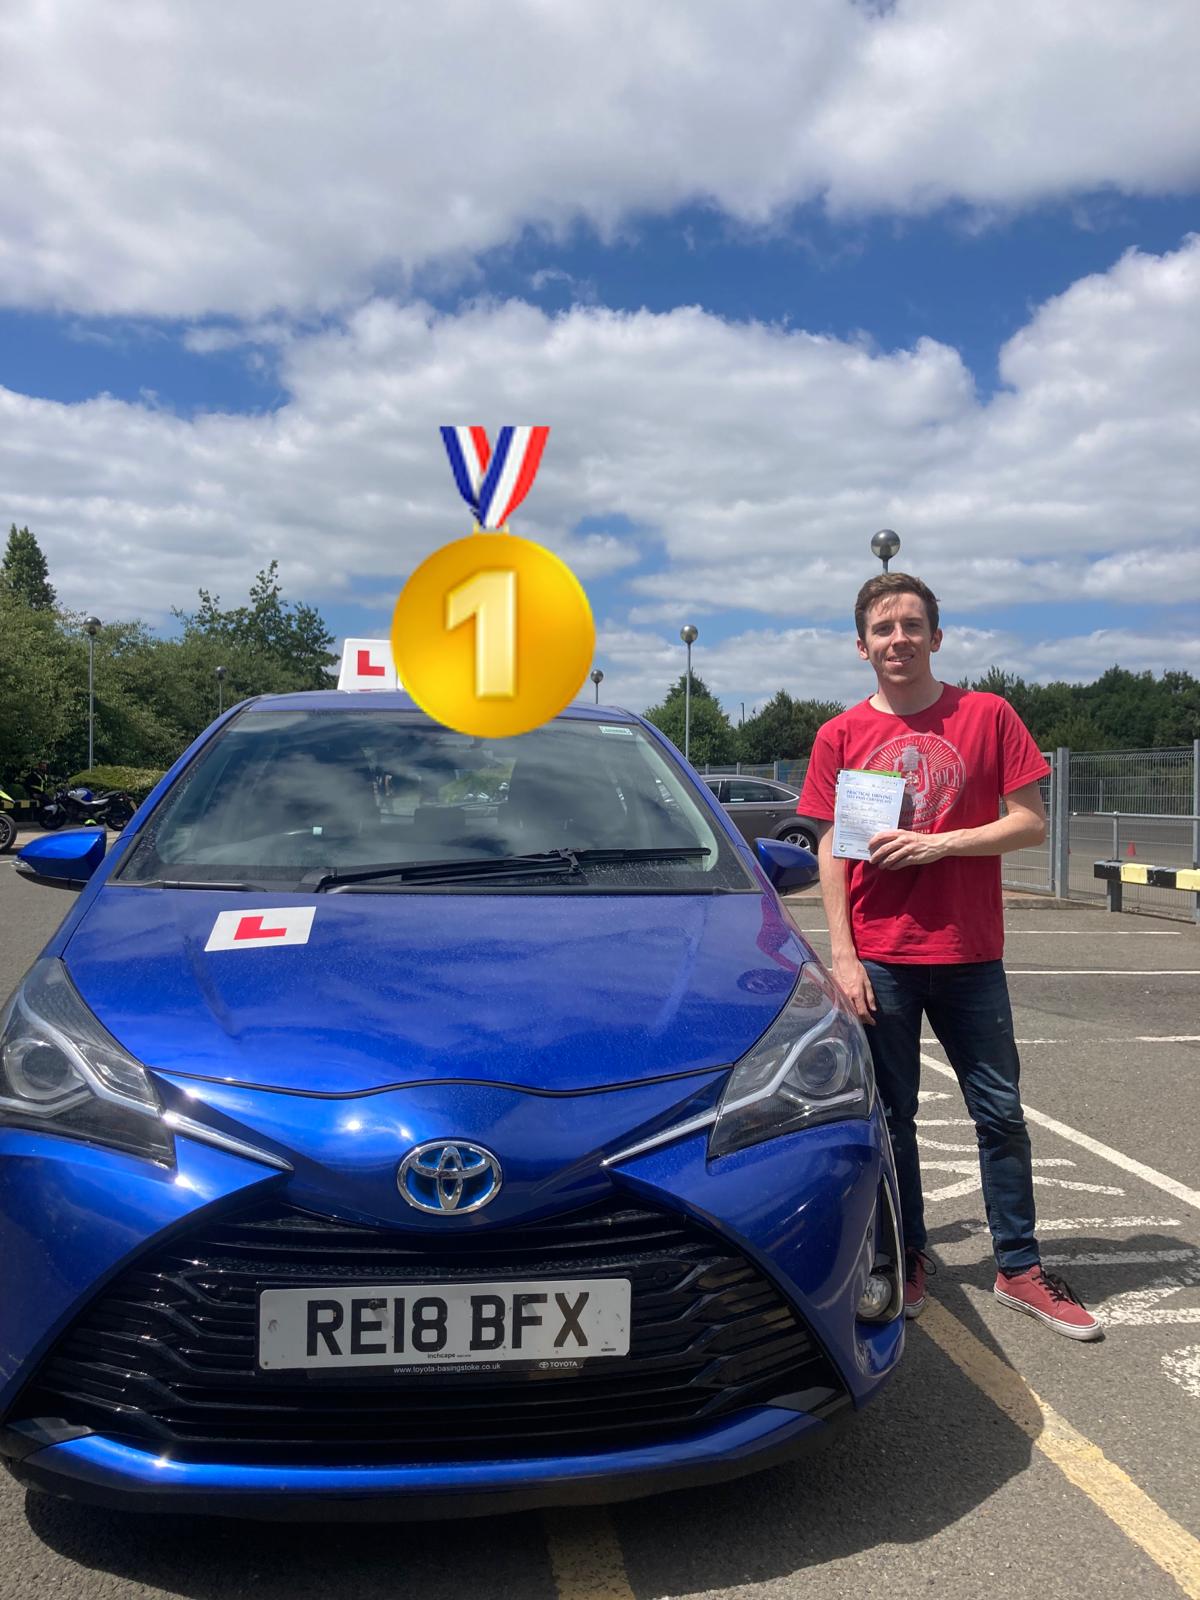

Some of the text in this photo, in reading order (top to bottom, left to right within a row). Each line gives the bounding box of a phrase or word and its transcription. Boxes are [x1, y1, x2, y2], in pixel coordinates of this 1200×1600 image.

[357, 650, 385, 676] L
[931, 764, 961, 788] ROCK
[234, 916, 287, 940] L
[306, 1292, 590, 1356] RE18 BFX
[393, 1363, 502, 1374] www.toyota-basingstoke.co.uk
